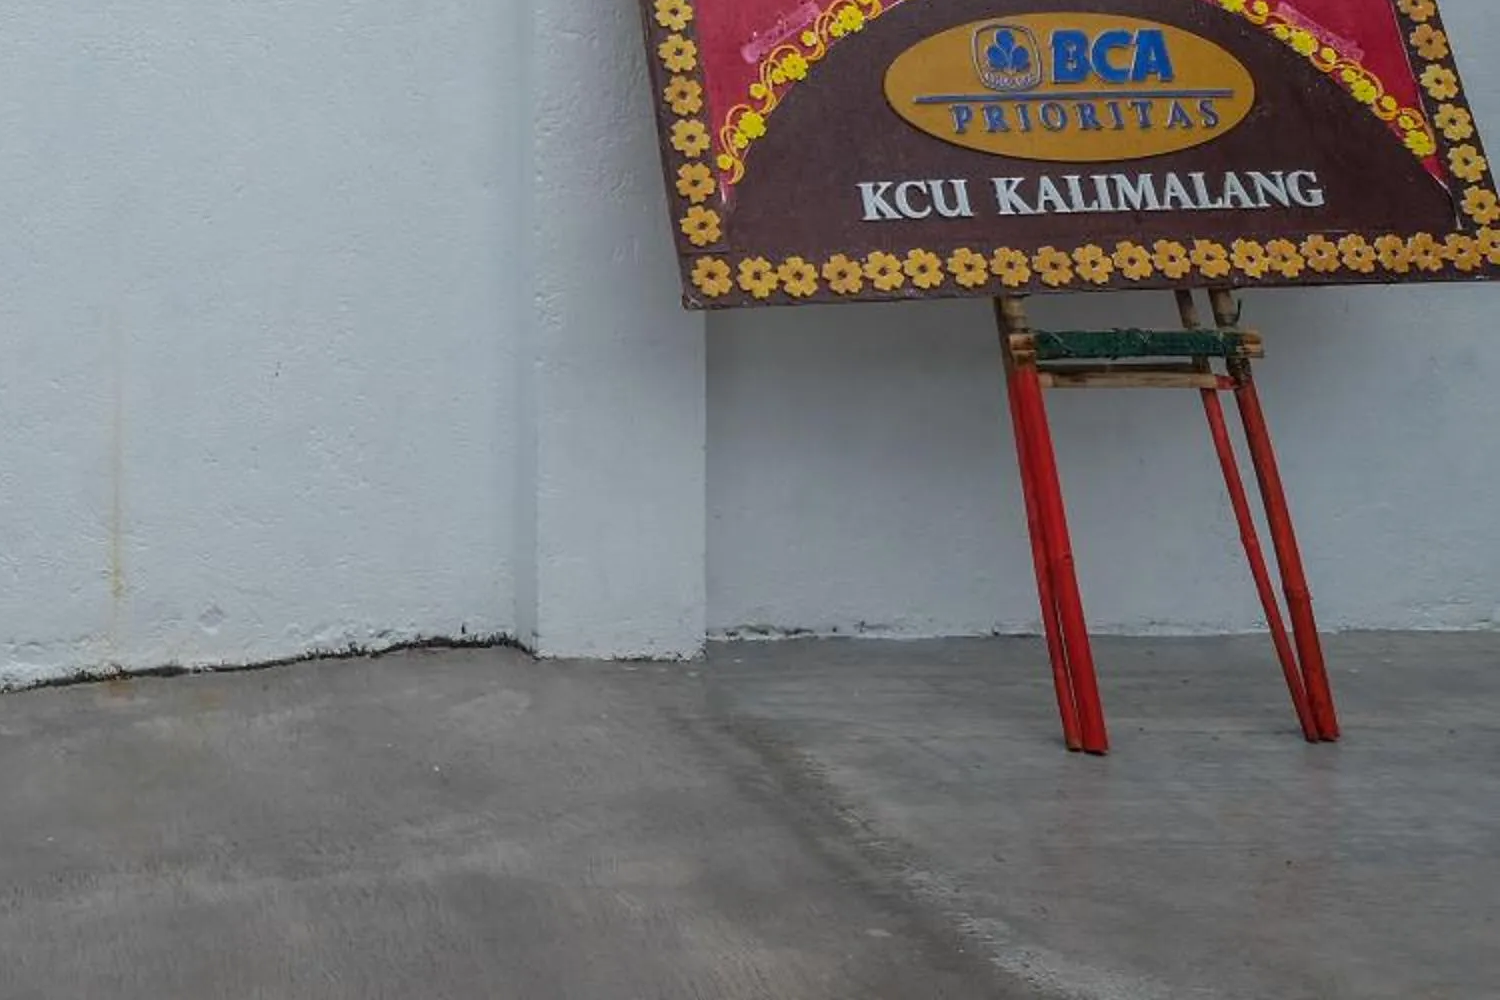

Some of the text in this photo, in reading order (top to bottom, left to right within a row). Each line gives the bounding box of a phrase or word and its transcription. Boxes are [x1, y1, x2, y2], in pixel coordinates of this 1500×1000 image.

[1049, 28, 1174, 84] BCA
[950, 99, 1221, 134] PRIORITAS
[858, 170, 1326, 221] KCU KALIMALANG
